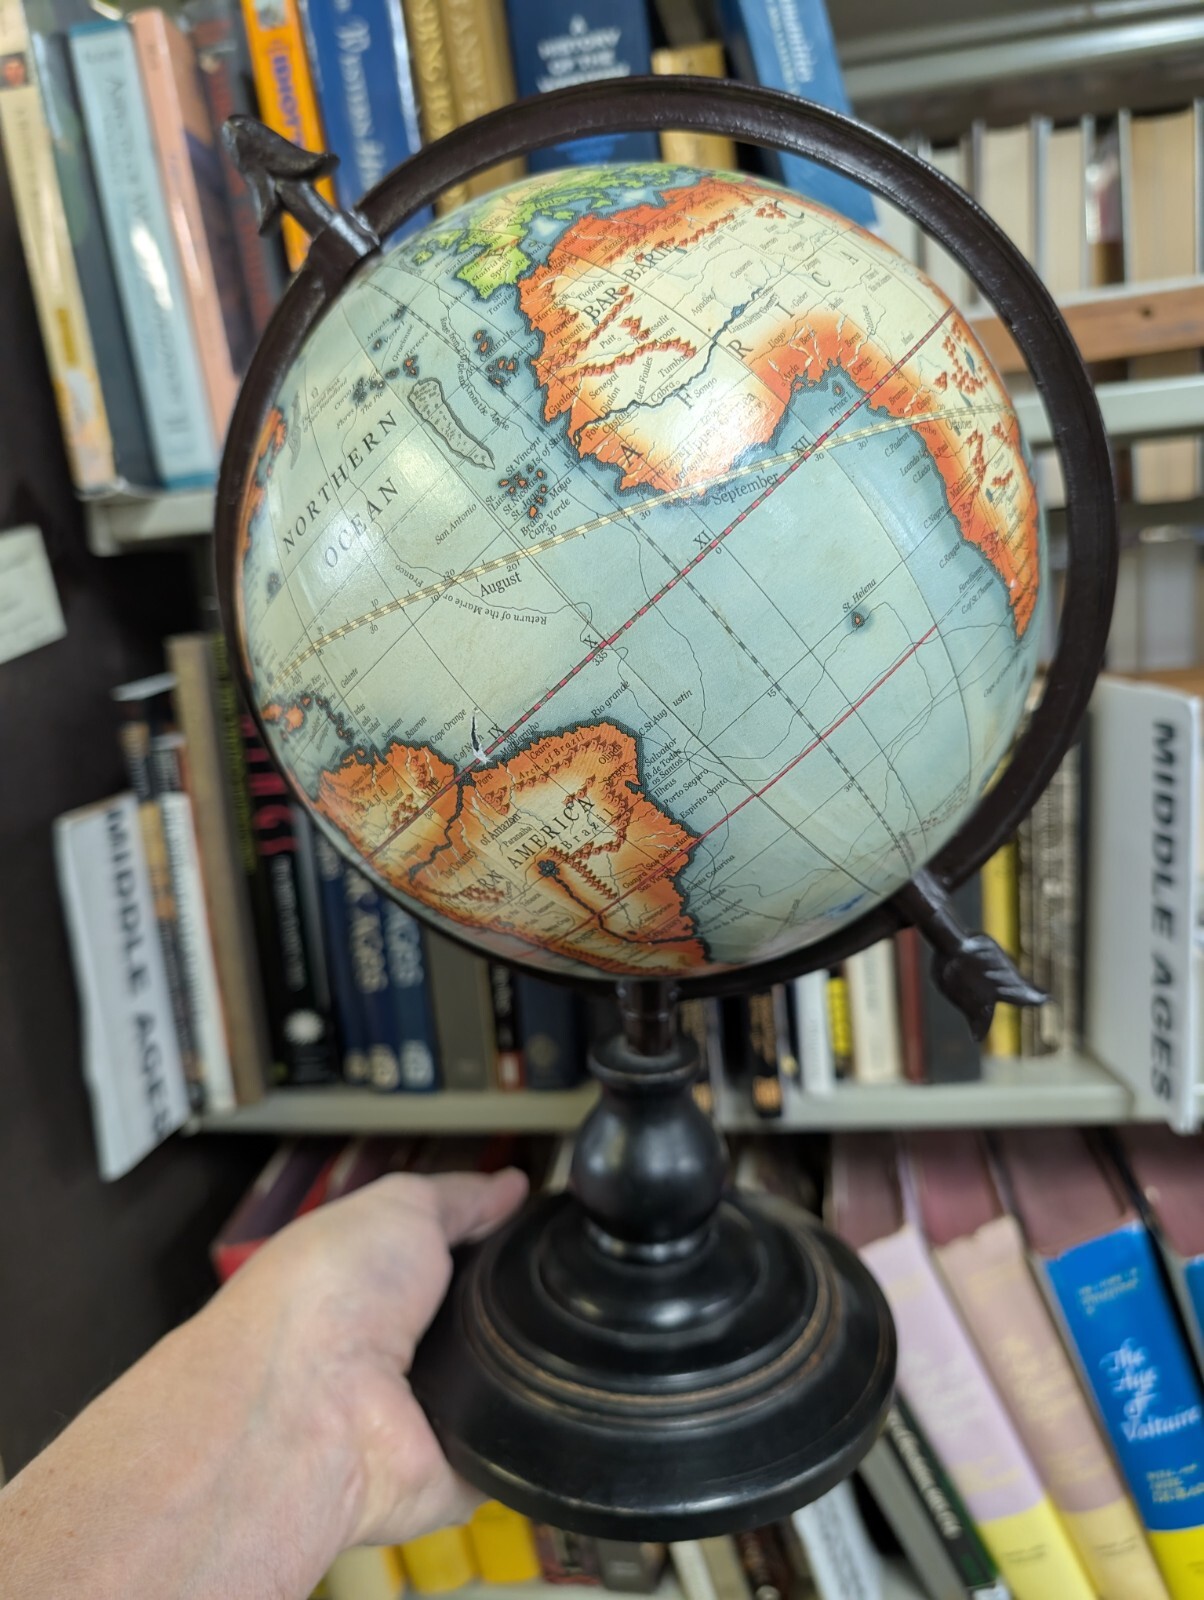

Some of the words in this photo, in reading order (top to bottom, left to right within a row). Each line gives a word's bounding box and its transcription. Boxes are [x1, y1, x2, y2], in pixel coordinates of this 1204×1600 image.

[589, 373, 619, 400] Senegal
[282, 410, 398, 554] NORTHERN
[711, 472, 779, 506] September
[324, 477, 399, 568] OCEAN
[434, 529, 450, 546] San
[449, 502, 477, 530] Antonio
[528, 520, 548, 540] Cape
[546, 499, 571, 523] Verde
[545, 524, 557, 536] 30
[639, 509, 651, 521] 30
[693, 530, 712, 550] XI
[480, 571, 522, 597] August
[506, 563, 517, 573] 20
[852, 578, 877, 603] Helena
[484, 609, 500, 620] the
[513, 615, 547, 625] Return
[590, 705, 605, 719] Rio
[604, 680, 630, 709] grande
[767, 689, 777, 698] 15
[429, 728, 445, 746] Cape
[443, 708, 467, 732] Orange
[644, 738, 677, 767] Salvador
[660, 757, 684, 778] Santos
[476, 773, 494, 788] Para
[663, 789, 684, 807] Porto
[682, 769, 709, 794] Seguro
[679, 795, 709, 820] Espirito
[706, 778, 728, 797] Santo
[480, 834, 491, 846] of
[489, 811, 521, 841] Amazon
[507, 798, 595, 870] AMERICA
[1150, 720, 1179, 938] MIDDLE
[105, 807, 151, 996] MIDDLE
[131, 1010, 173, 1137] AGES
[1149, 952, 1177, 1100] AGES
[1099, 1337, 1147, 1375] The
[1120, 1402, 1201, 1444] Voltaire
